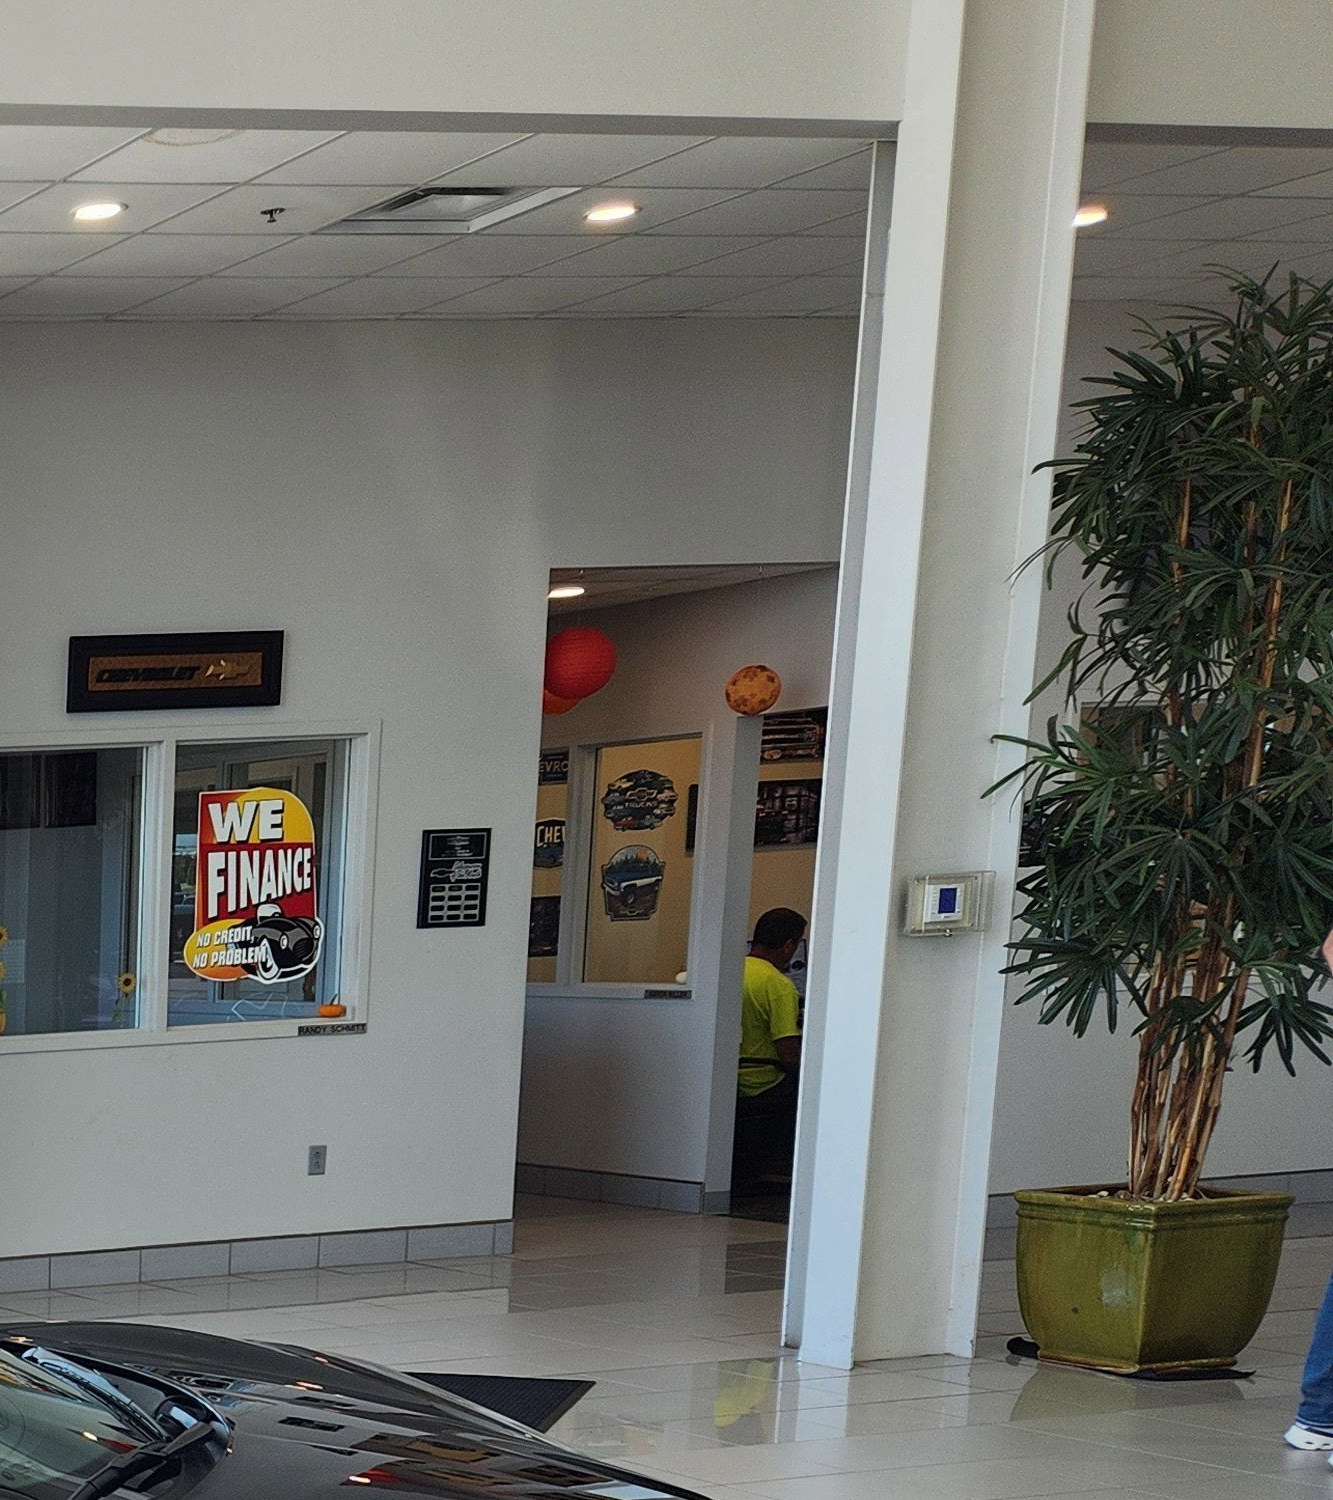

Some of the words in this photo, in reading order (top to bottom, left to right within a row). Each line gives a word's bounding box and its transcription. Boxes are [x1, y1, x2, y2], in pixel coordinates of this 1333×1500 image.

[207, 799, 284, 843] WE
[207, 846, 312, 919] FINANCE
[196, 932, 212, 948] NO
[214, 925, 255, 944] CREDIT,
[193, 952, 208, 968] NO
